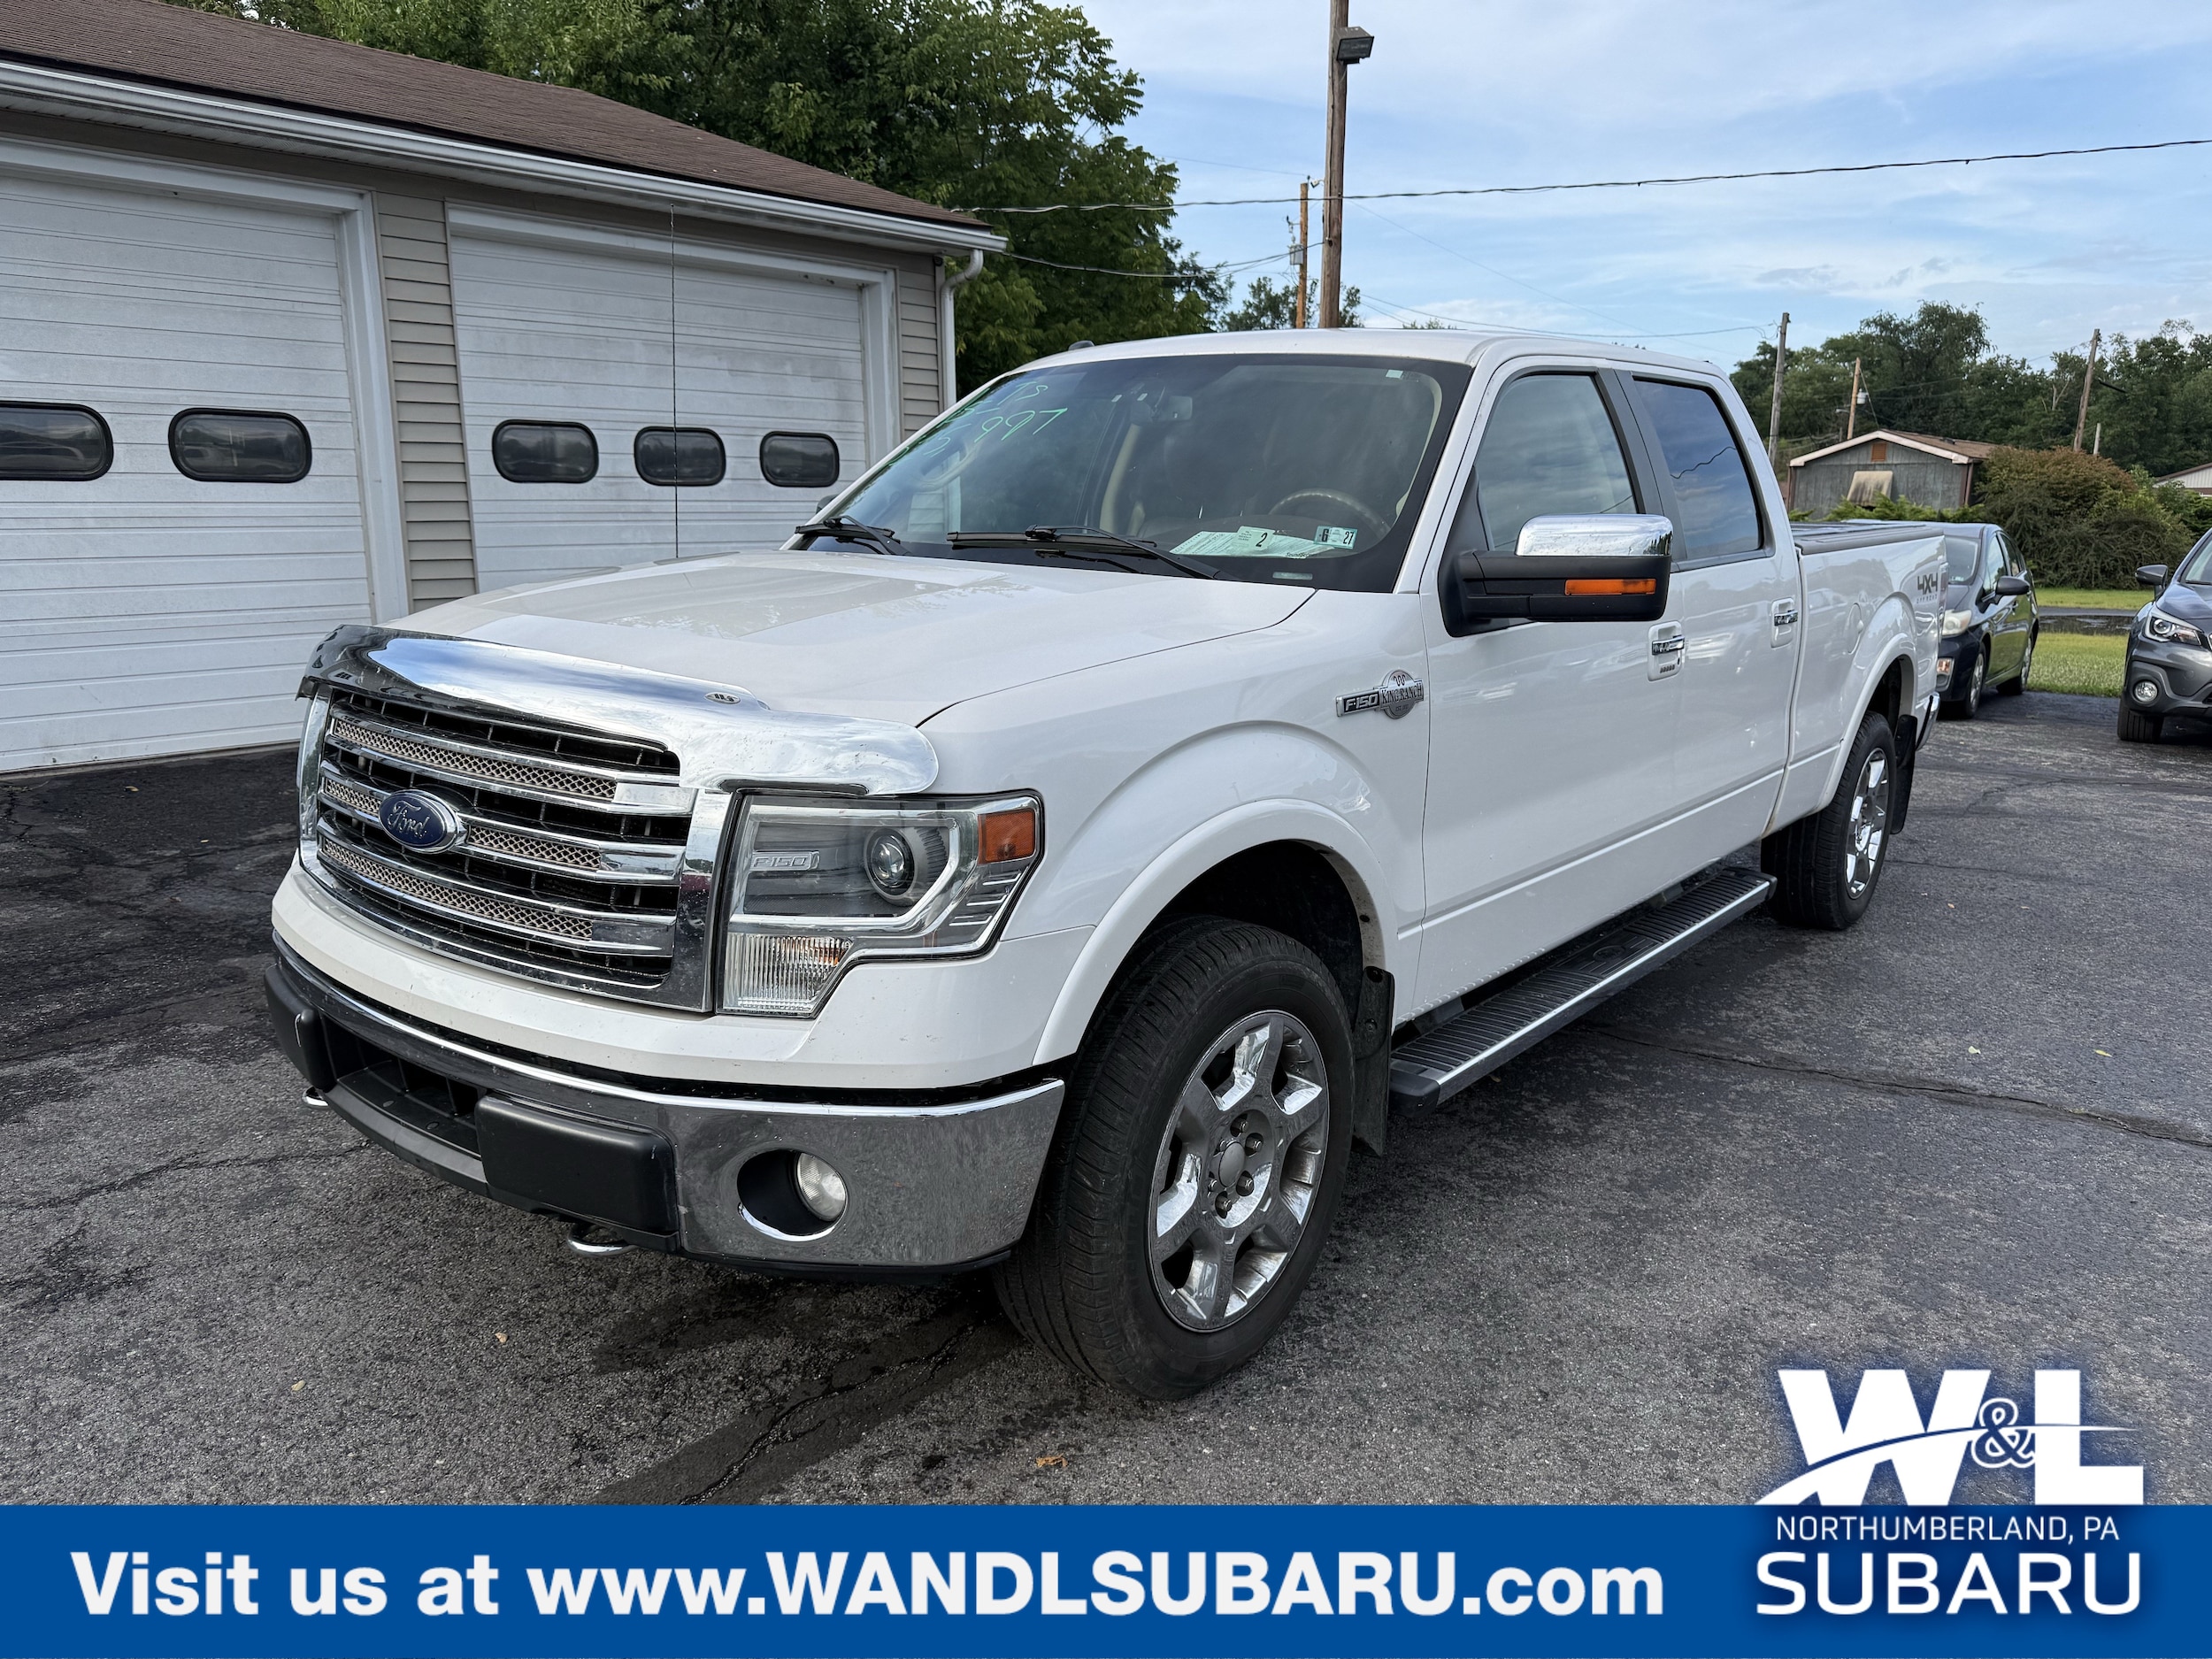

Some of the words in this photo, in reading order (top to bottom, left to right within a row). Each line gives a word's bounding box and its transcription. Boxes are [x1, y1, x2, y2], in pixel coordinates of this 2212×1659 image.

[1256, 532, 1268, 548] 2
[1321, 528, 1330, 542] 6
[1342, 531, 1355, 545] 27
[1381, 688, 1400, 704] KING
[1400, 682, 1423, 702] RANCH
[388, 800, 431, 840] Ford
